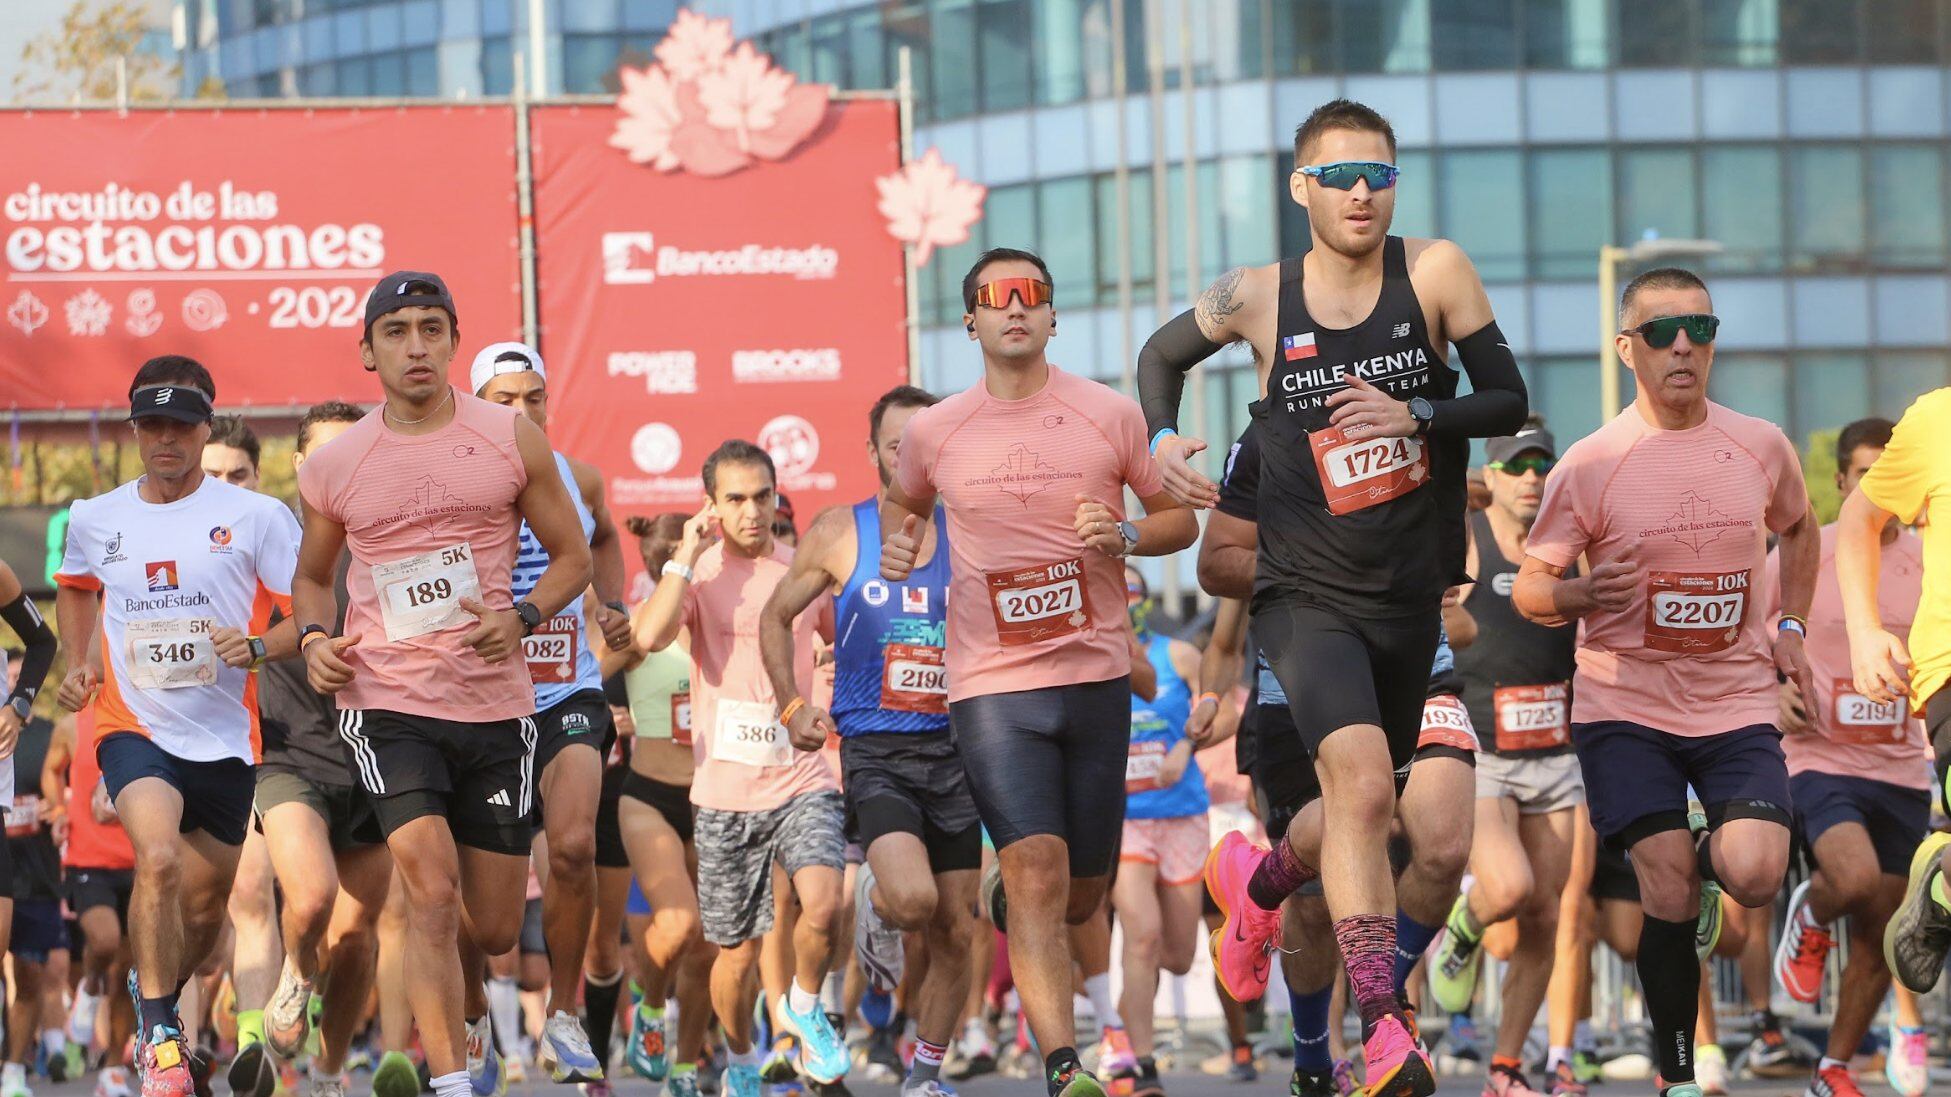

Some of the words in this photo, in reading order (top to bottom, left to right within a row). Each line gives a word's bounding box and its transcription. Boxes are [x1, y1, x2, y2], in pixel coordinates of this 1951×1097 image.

[4, 182, 162, 222] circuito
[165, 180, 215, 220] de
[219, 180, 279, 220] las
[5, 221, 385, 271] estaciones
[656, 244, 839, 277] BancoEstado
[731, 348, 841, 376] BROOKS
[1282, 364, 1346, 391] CHILE
[1353, 348, 1428, 378] KENYA
[1387, 374, 1429, 392] TEAM
[1344, 438, 1410, 478] 1724
[964, 475, 1002, 487] circuito
[1003, 473, 1016, 483] de
[1016, 472, 1031, 482] las
[1032, 470, 1083, 480] estaciones
[372, 511, 410, 527] circuito
[411, 508, 425, 519] de
[425, 507, 440, 517] las
[440, 503, 492, 515] estaciones
[1639, 526, 1676, 538] circuito
[1677, 523, 1689, 533] de
[1689, 521, 1704, 531] las
[1705, 518, 1753, 530] estaciones
[441, 547, 468, 566] 5K
[1047, 560, 1082, 581] 10K
[1716, 572, 1748, 591] 10K
[125, 591, 210, 613] BancoEstado
[406, 578, 452, 607] 189
[1008, 586, 1073, 618] 2027
[1664, 600, 1738, 624] 2207
[190, 620, 211, 633] 5K
[549, 617, 575, 632] 10K
[149, 643, 195, 663] 346
[1516, 707, 1556, 726] 1723
[737, 724, 777, 743] 386
[1676, 1030, 1687, 1067] MEIKAN
